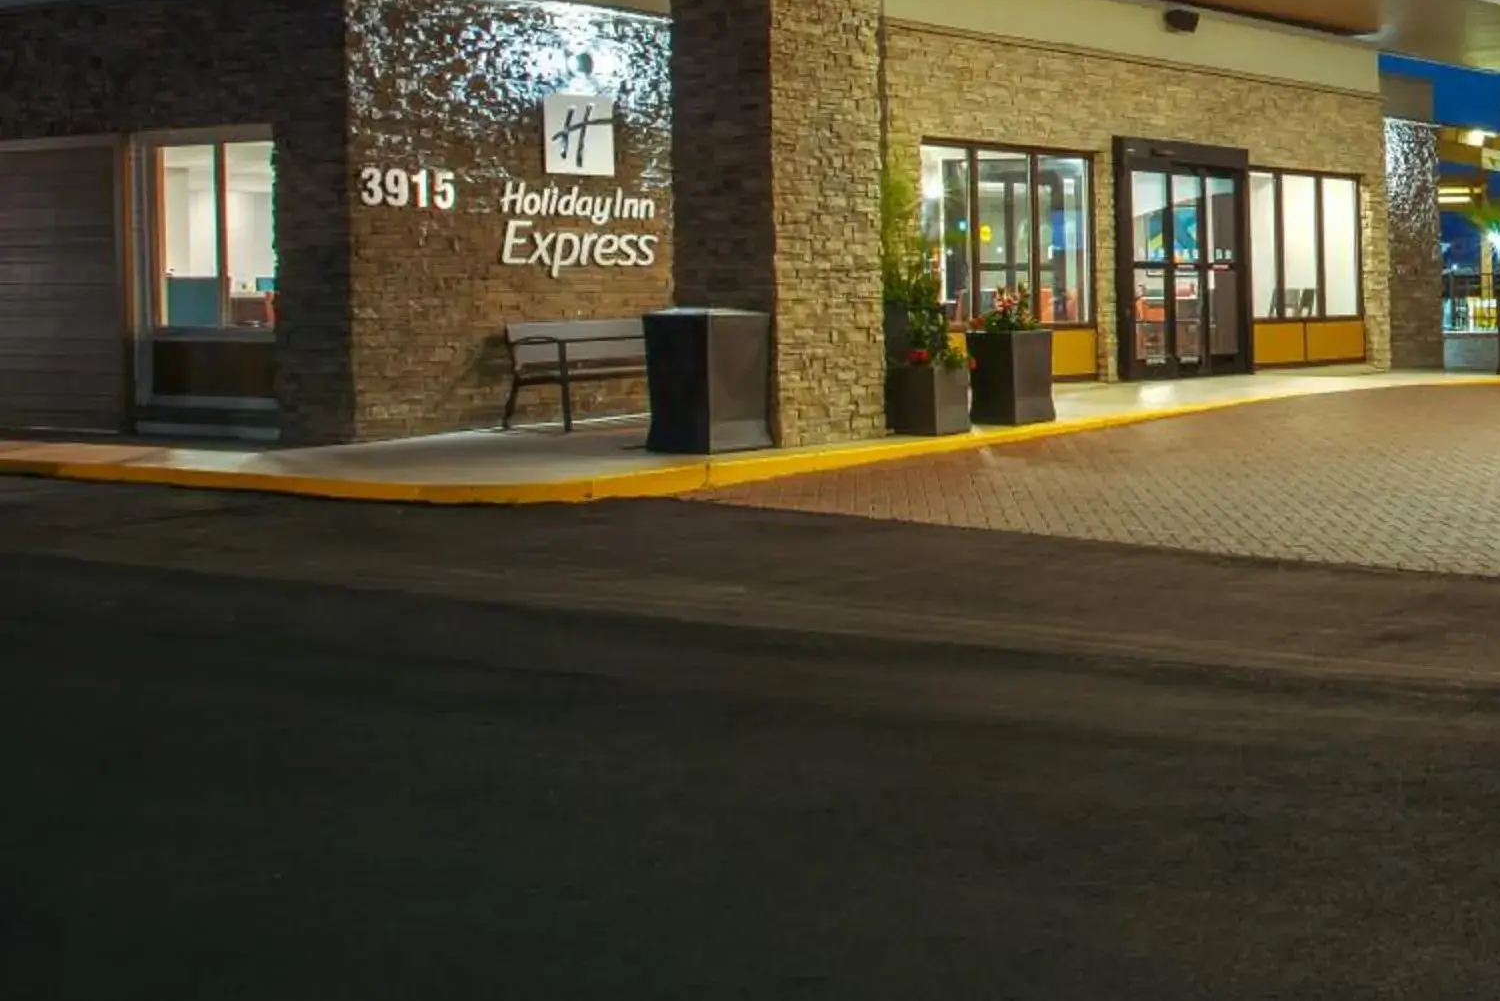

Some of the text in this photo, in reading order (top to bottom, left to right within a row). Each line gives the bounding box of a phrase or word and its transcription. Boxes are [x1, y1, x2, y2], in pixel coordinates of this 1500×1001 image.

[361, 167, 455, 210] 3915
[500, 181, 655, 226] Holiday Inn
[502, 220, 659, 278] Express
